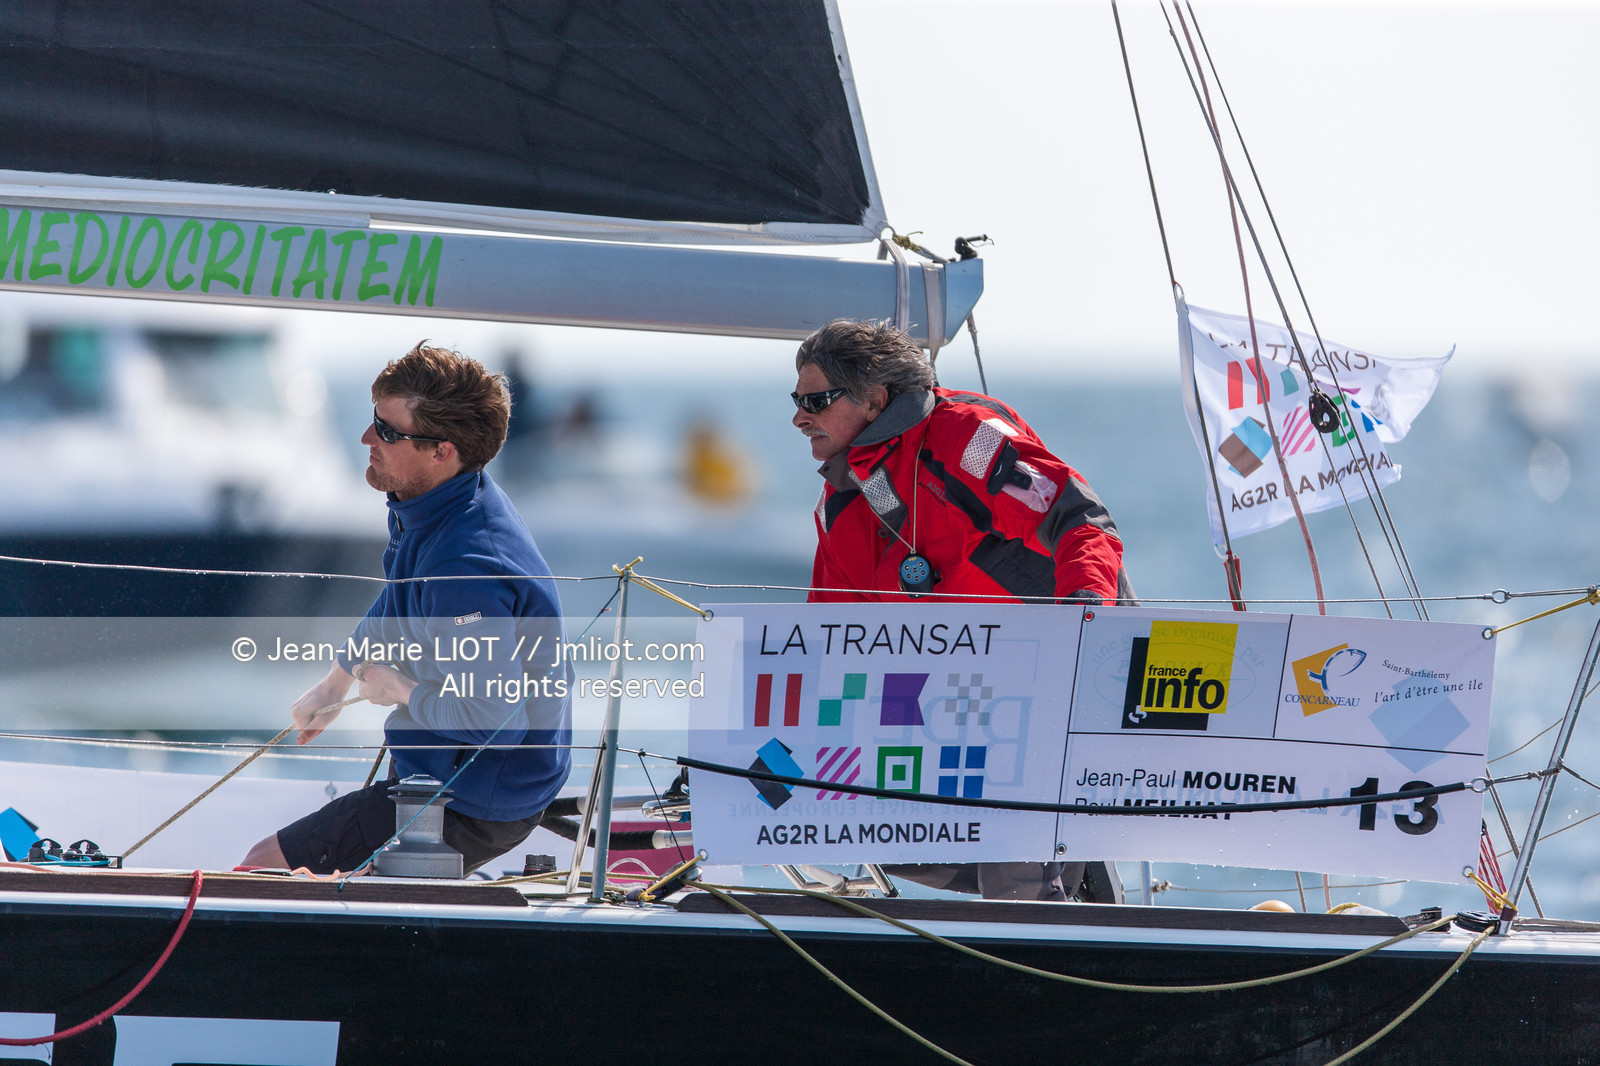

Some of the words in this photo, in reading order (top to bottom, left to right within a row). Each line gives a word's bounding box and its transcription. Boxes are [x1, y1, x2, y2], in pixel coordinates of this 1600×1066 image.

[0, 207, 443, 307] MEDIOCRITATEM
[927, 481, 947, 502] AIGL
[1231, 482, 1279, 512] AG2R
[759, 624, 807, 656] LA
[820, 624, 1001, 656] TRANSAT
[1148, 664, 1187, 676] france
[1381, 659, 1451, 679] Saint-Barthélemy
[1144, 667, 1225, 710] info
[1443, 683, 1464, 693] une
[1468, 680, 1483, 690] île
[1284, 693, 1361, 708] CONCARNEAU
[1076, 767, 1177, 788] Jean-Paul
[1182, 771, 1296, 795] MOUREN
[1350, 777, 1439, 835] 13
[757, 824, 818, 845] AG2R
[824, 824, 854, 845] LA
[858, 822, 981, 844] MONDIALE
